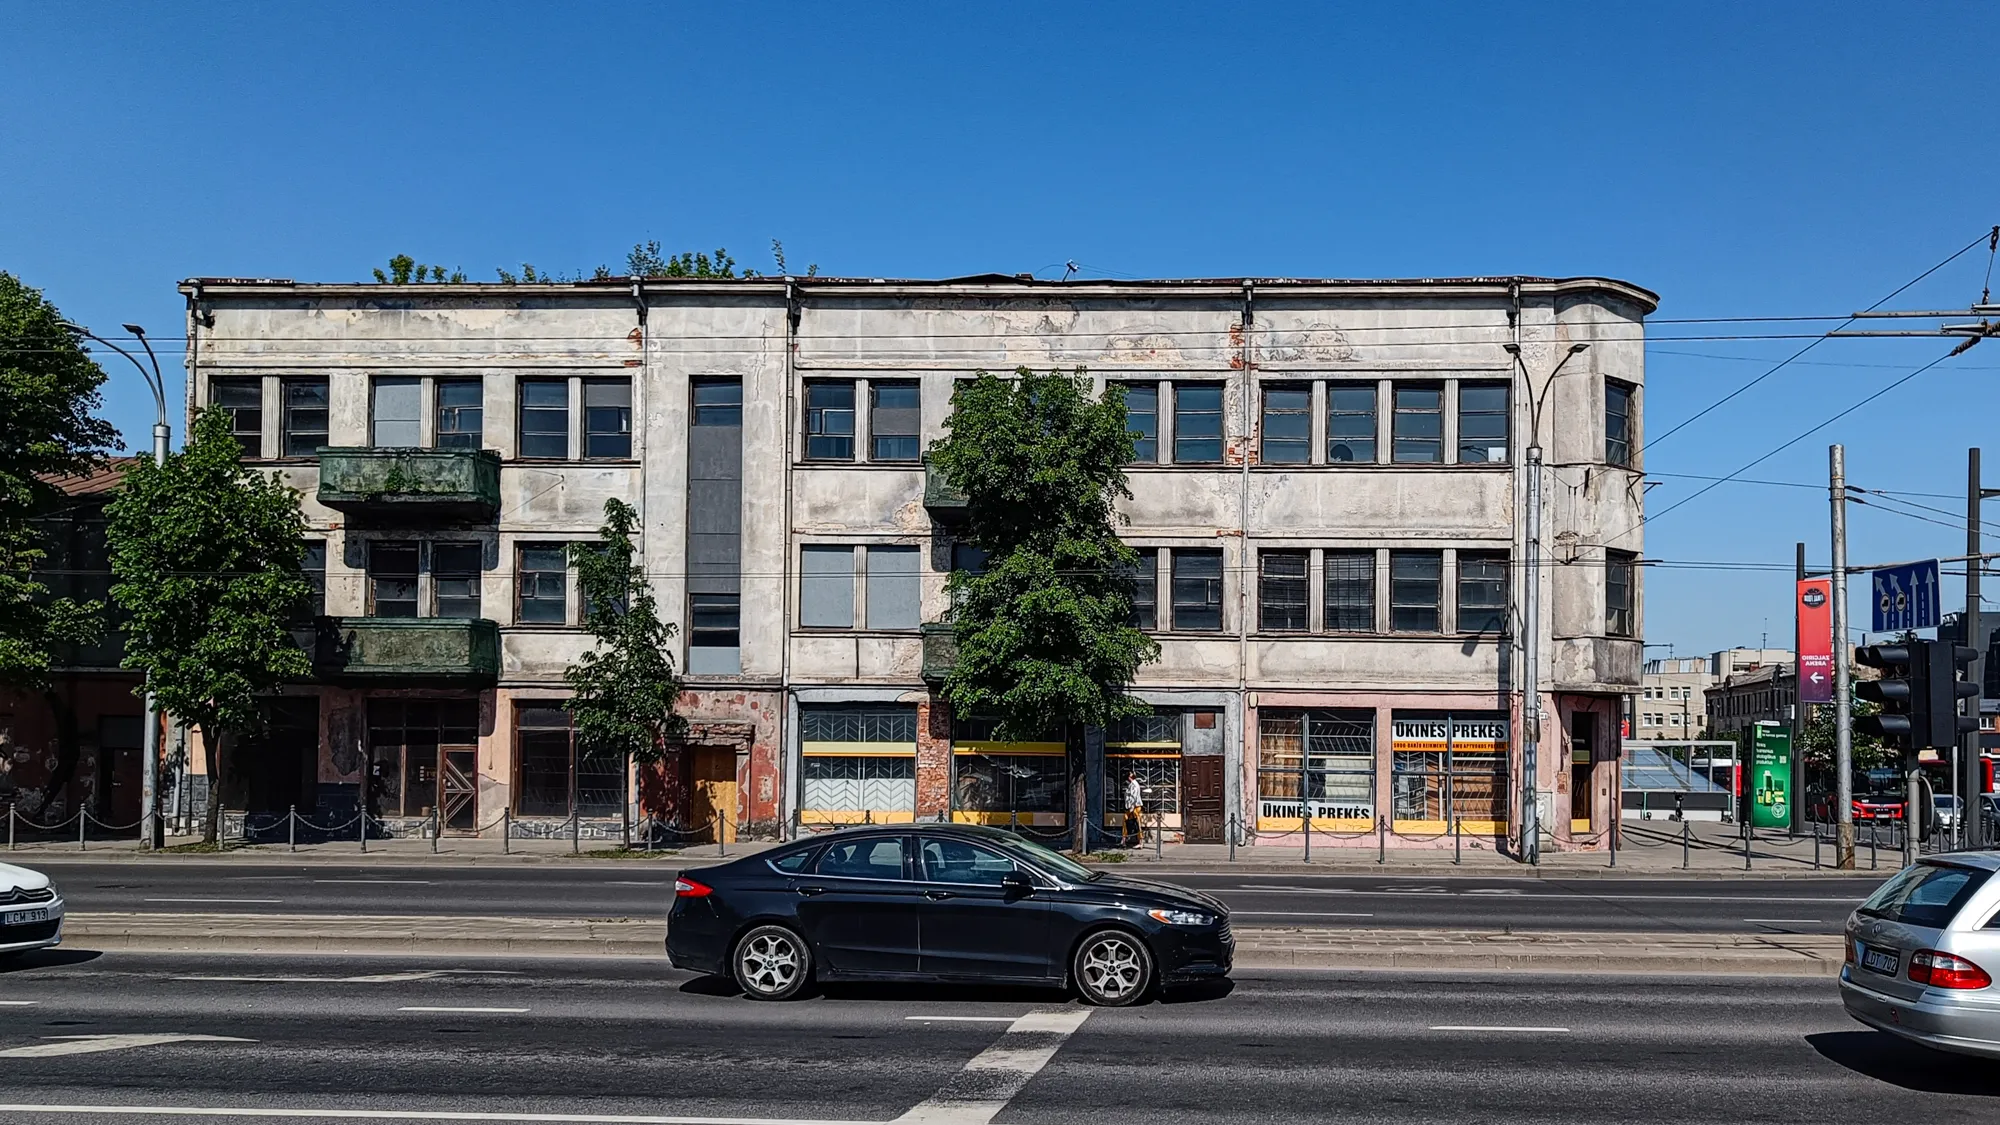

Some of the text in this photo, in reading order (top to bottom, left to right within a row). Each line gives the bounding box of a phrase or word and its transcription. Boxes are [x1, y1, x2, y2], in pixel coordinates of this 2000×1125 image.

[1395, 721, 1505, 739] ŪKINĖS PREKĖS
[1263, 803, 1370, 819] ŪKINĖS PREKĖS
[6, 910, 46, 922] LCM 913
